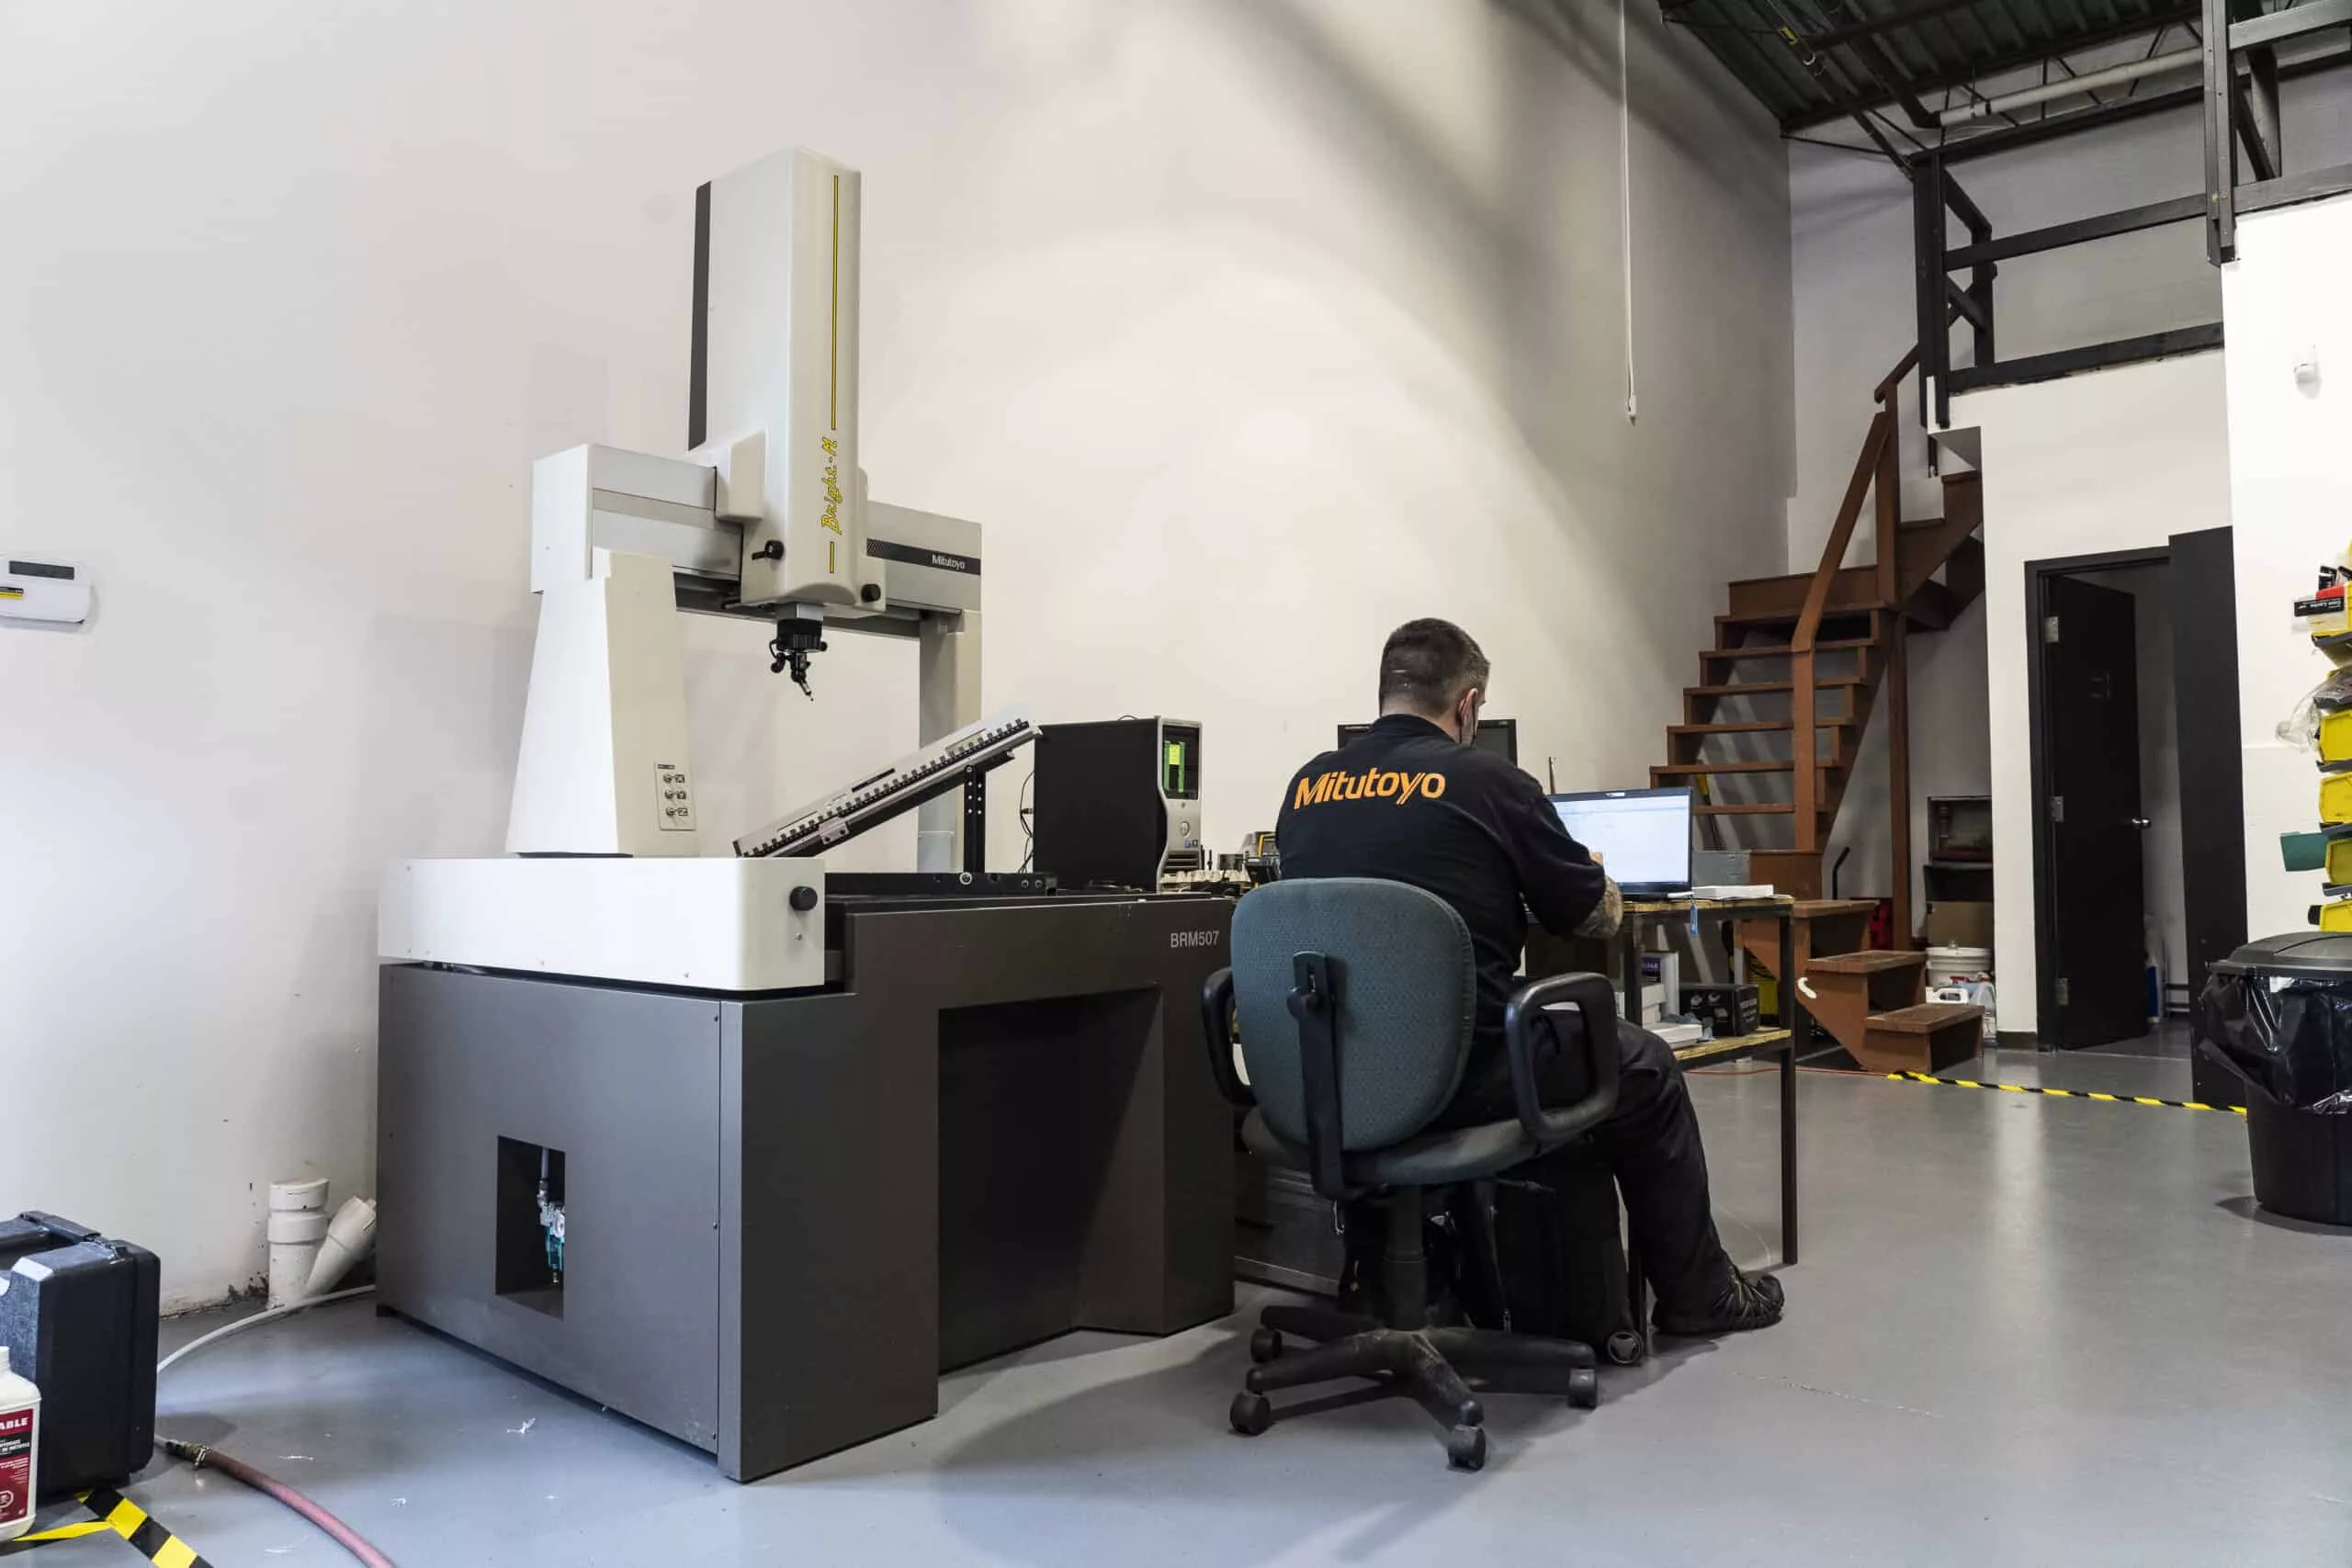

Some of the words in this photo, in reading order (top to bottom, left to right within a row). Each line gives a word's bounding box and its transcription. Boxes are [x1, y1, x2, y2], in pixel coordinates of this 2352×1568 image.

[932, 554, 966, 570] Mitutoyo
[1294, 767, 1448, 809] Mitutoyo
[1170, 930, 1220, 948] BRM507
